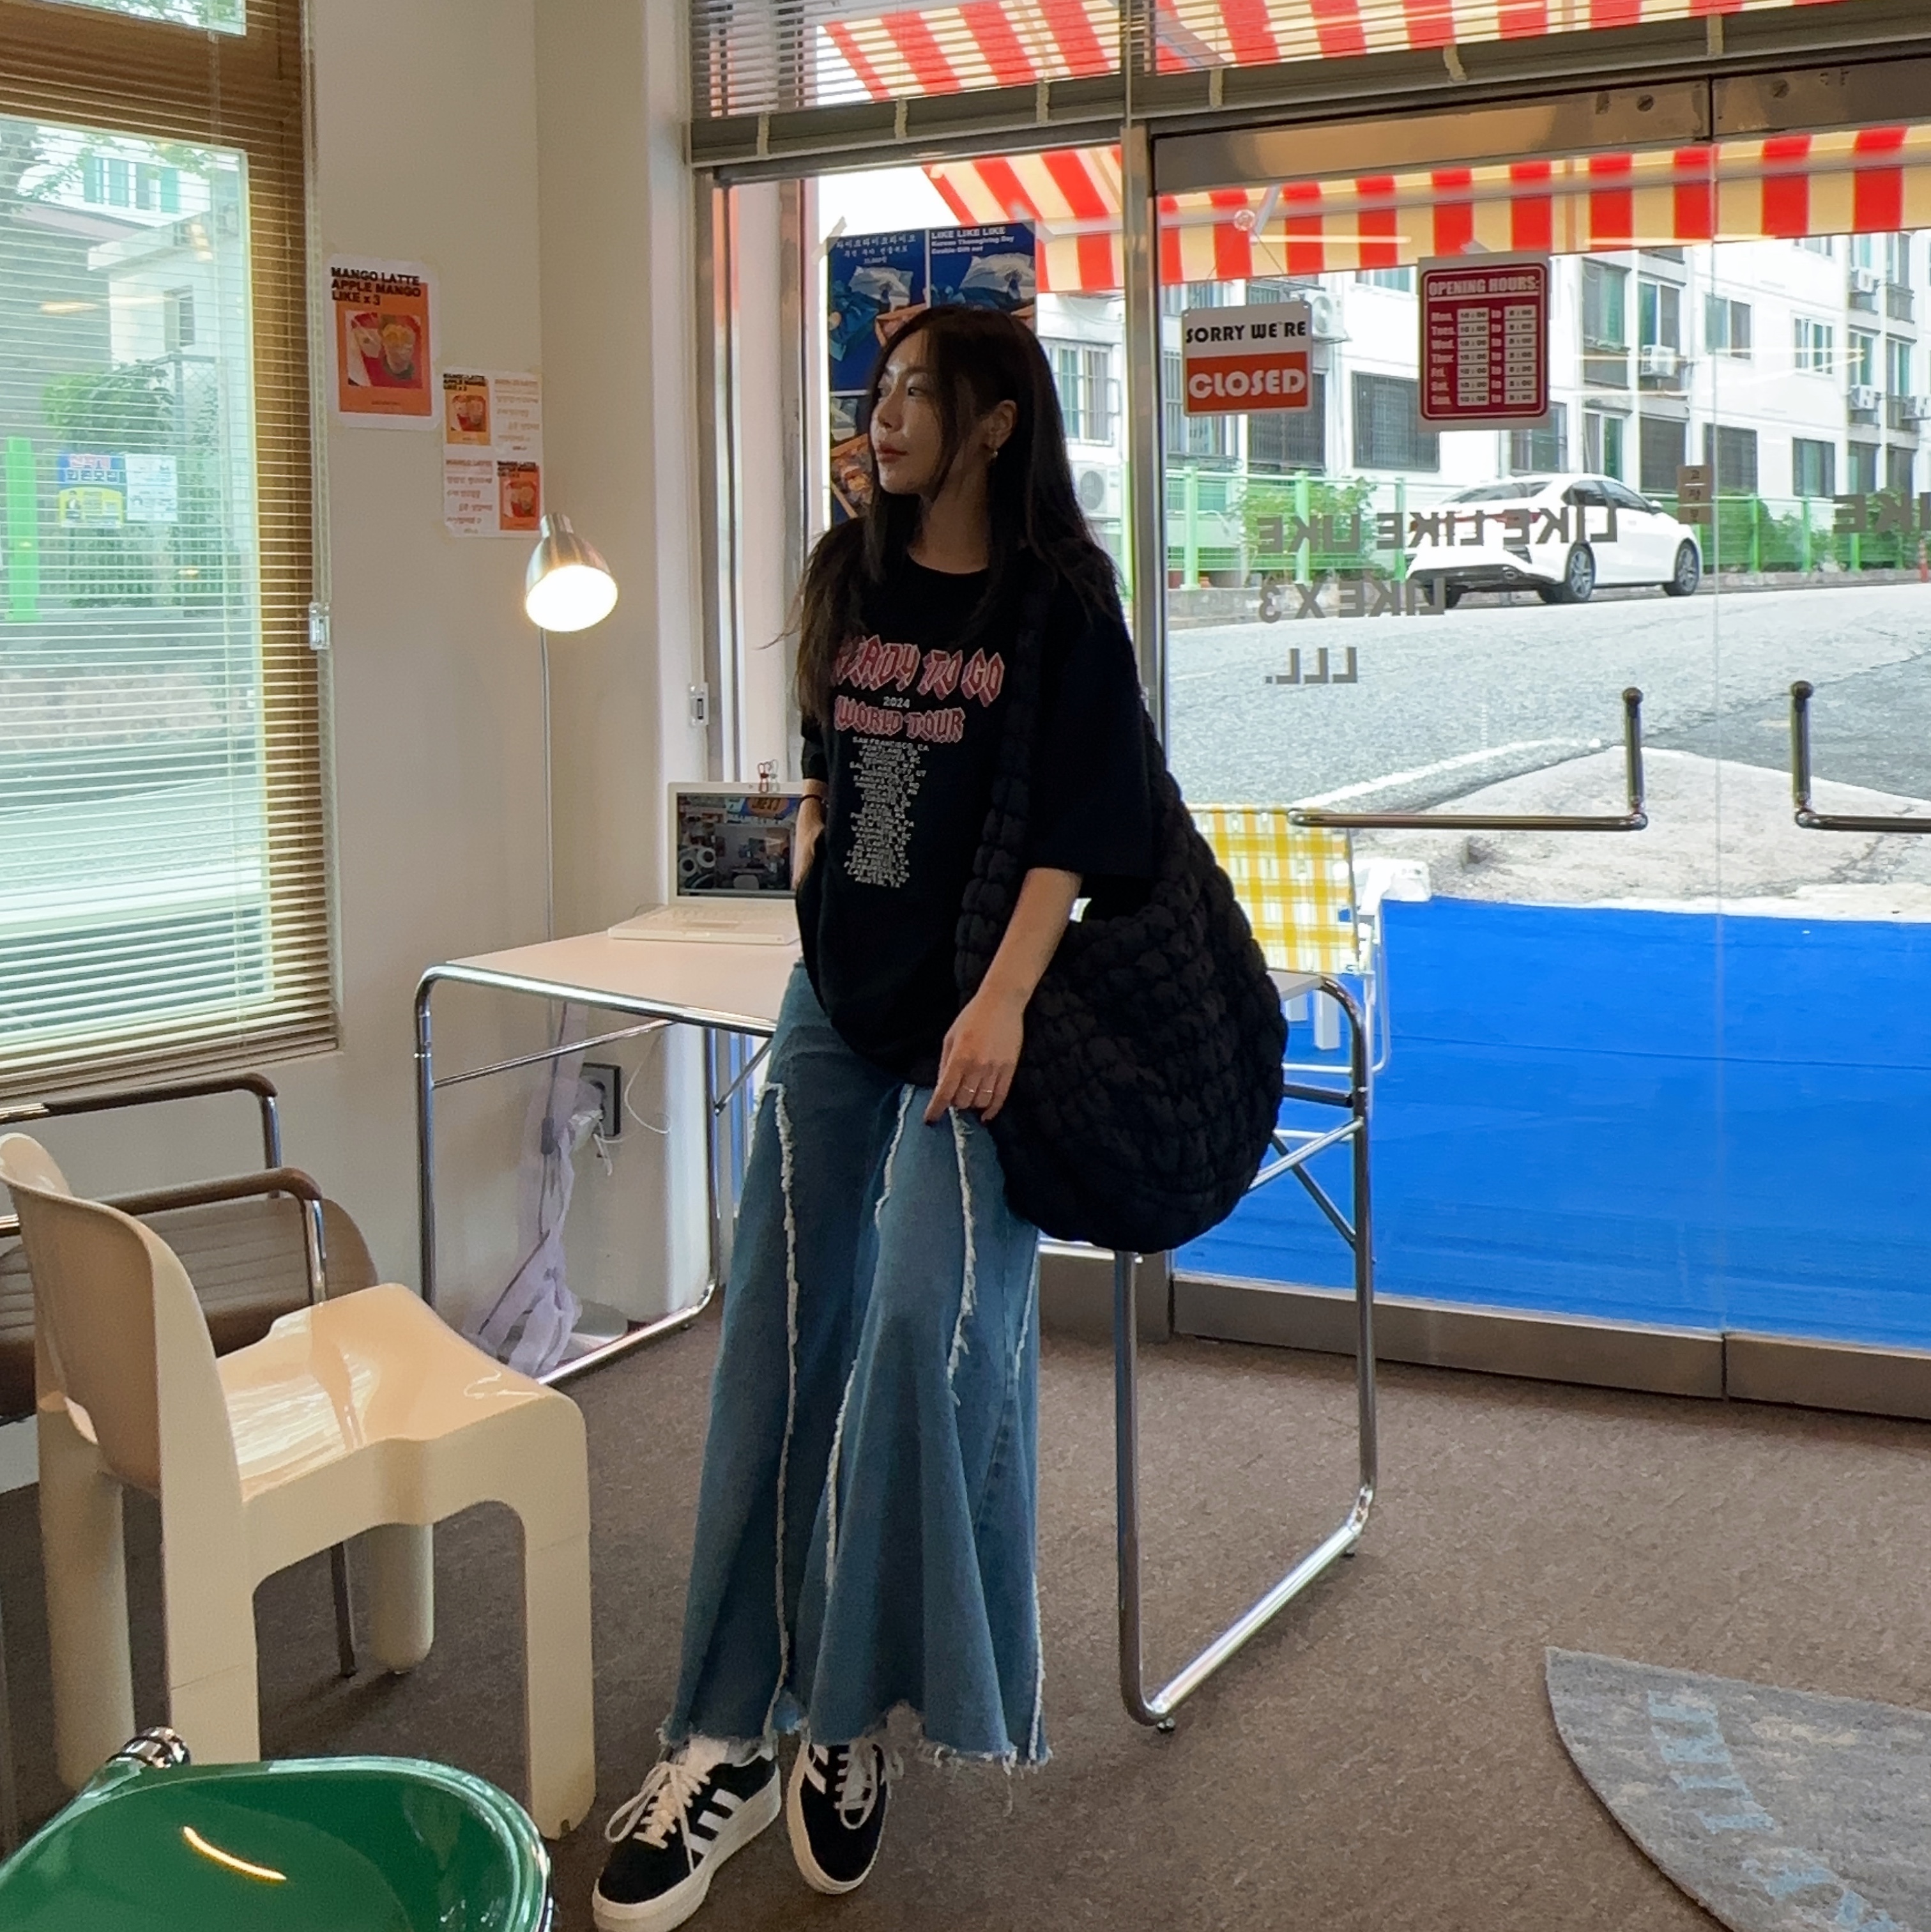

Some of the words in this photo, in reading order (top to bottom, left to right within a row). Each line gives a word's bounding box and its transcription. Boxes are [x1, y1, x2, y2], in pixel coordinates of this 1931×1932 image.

[931, 231, 954, 239] LIKE
[957, 229, 980, 237] LIKE
[982, 227, 1005, 236] LIKE
[331, 267, 378, 281] MANGO
[381, 272, 420, 286] LATTE
[332, 279, 372, 293] APPLE
[376, 284, 421, 297] MANGO
[1429, 279, 1486, 296] OPENING
[332, 291, 360, 303] LIKE
[373, 295, 381, 305] 3
[1186, 325, 1245, 344] SORRY
[1251, 321, 1306, 339] WE'RE
[1189, 368, 1306, 399] CLOSED
[917, 649, 963, 701] TO
[960, 647, 1005, 708] GO
[883, 696, 910, 708] 2024
[834, 695, 904, 737] WORLD
[903, 707, 966, 743] TOUR
